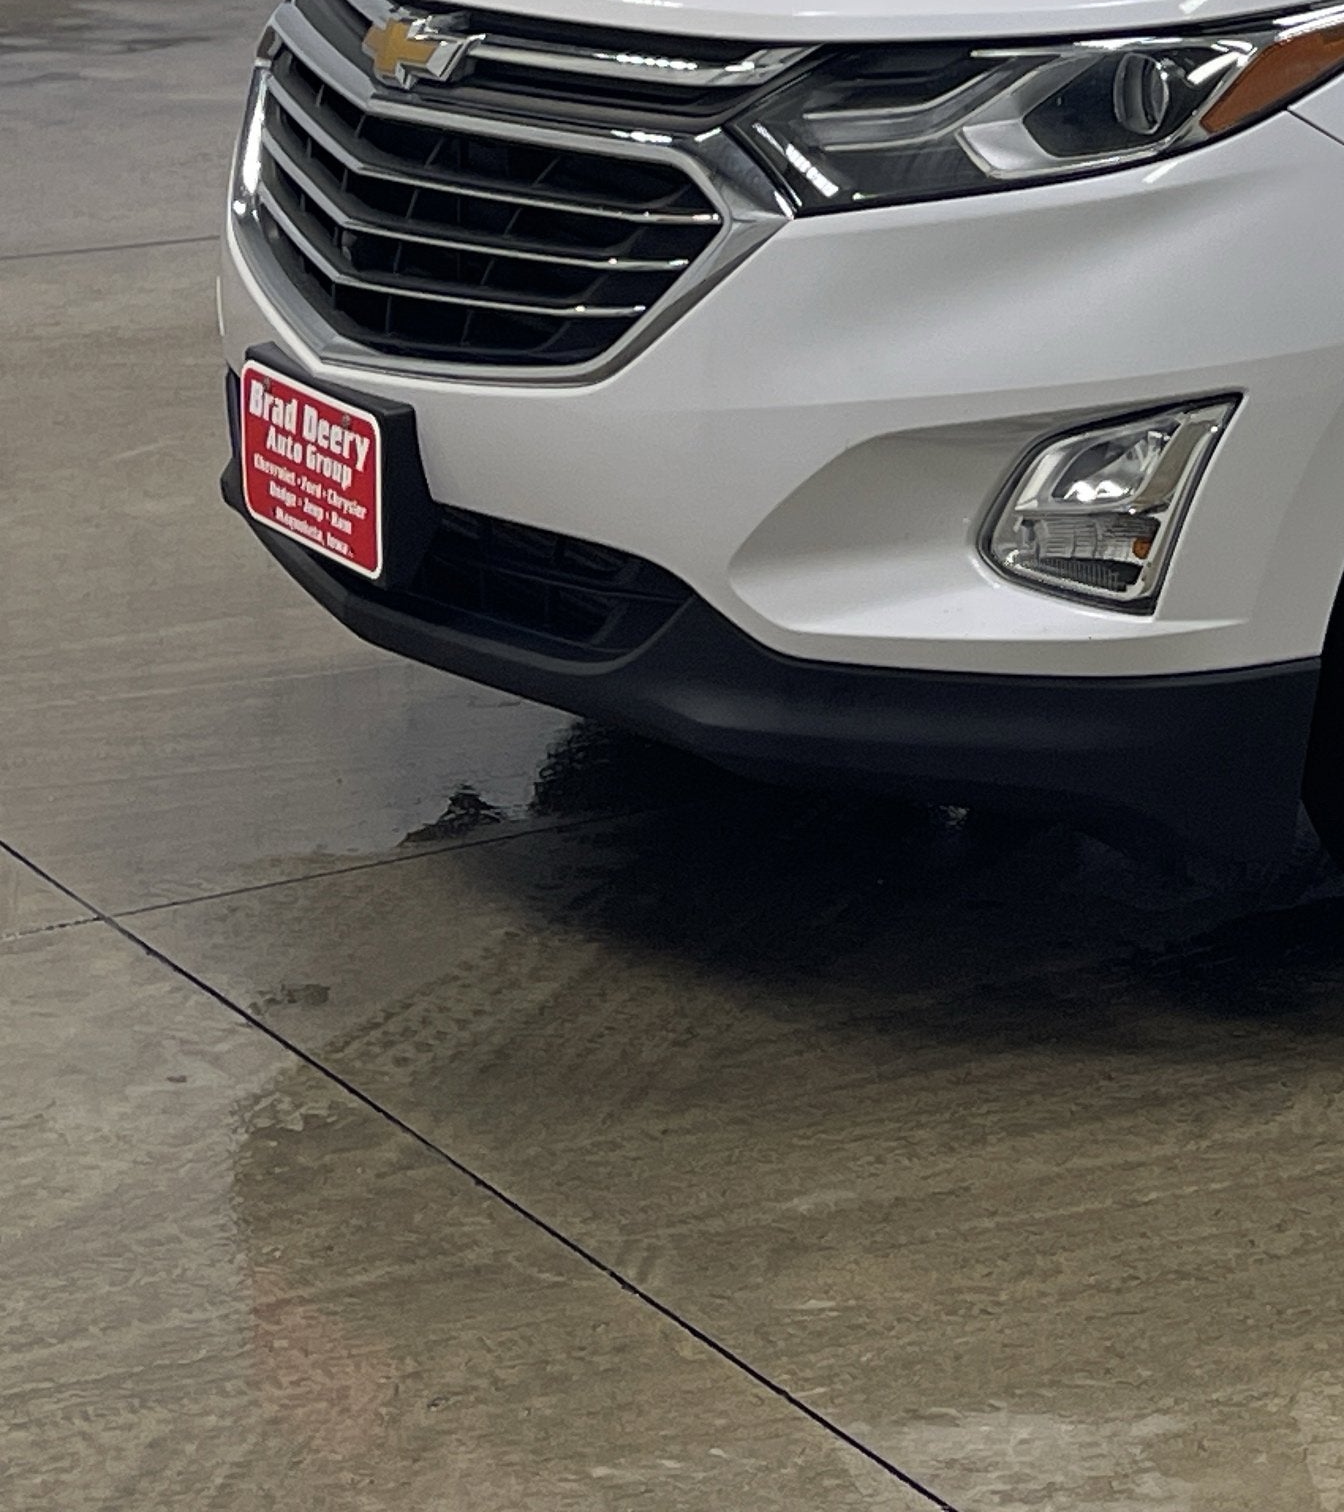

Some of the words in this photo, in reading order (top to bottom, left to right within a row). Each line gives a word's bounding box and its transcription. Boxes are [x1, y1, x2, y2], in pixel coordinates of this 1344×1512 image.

[249, 378, 299, 435] Brad
[303, 403, 371, 473] Deery
[266, 425, 303, 464] Auto
[306, 444, 352, 491] Group
